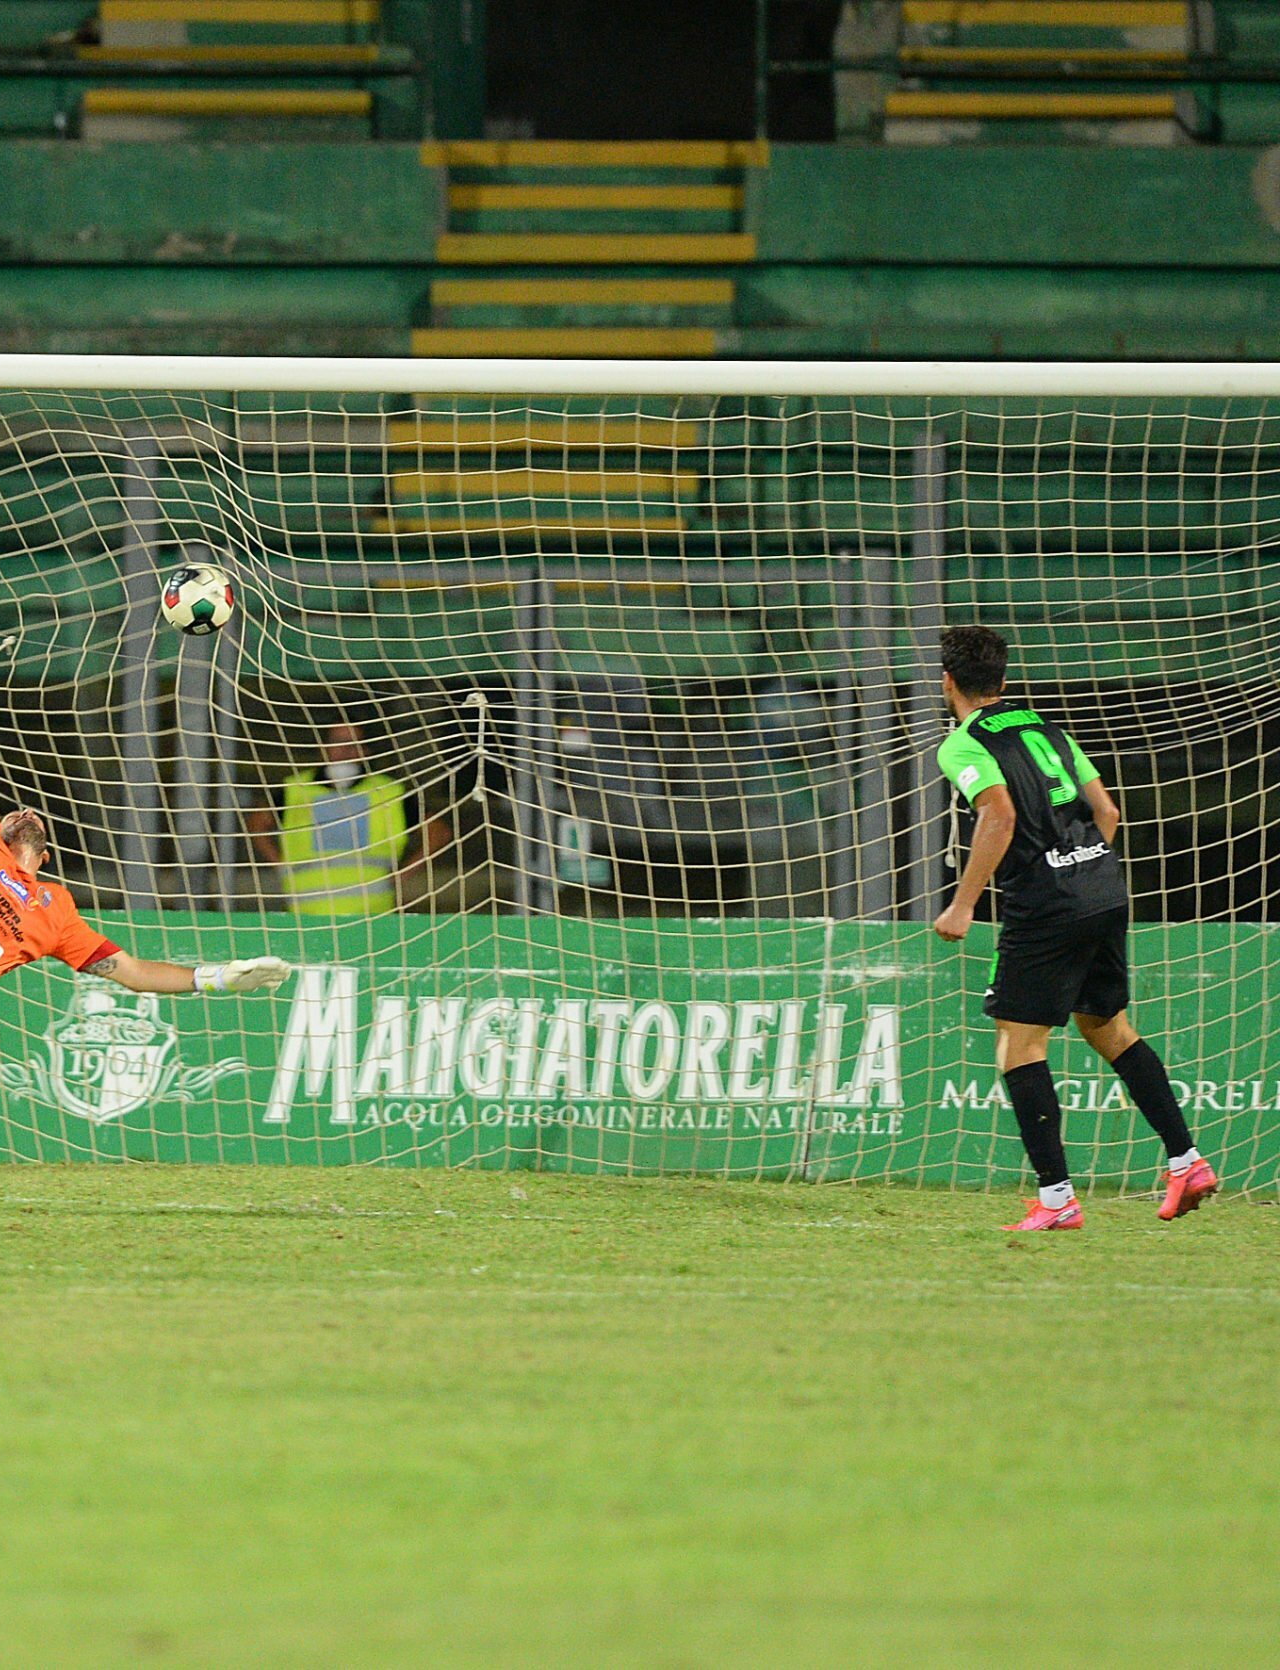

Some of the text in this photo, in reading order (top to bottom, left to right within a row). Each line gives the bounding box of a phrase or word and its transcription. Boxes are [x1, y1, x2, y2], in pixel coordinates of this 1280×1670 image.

[1019, 728, 1080, 807] 9
[262, 966, 904, 1124] MANGIATORELLA
[66, 1049, 148, 1084] 1904
[939, 1079, 1280, 1111] MAGIAOREL
[362, 1103, 904, 1135] ACQUA OLIGOMINERALE NATURALE
